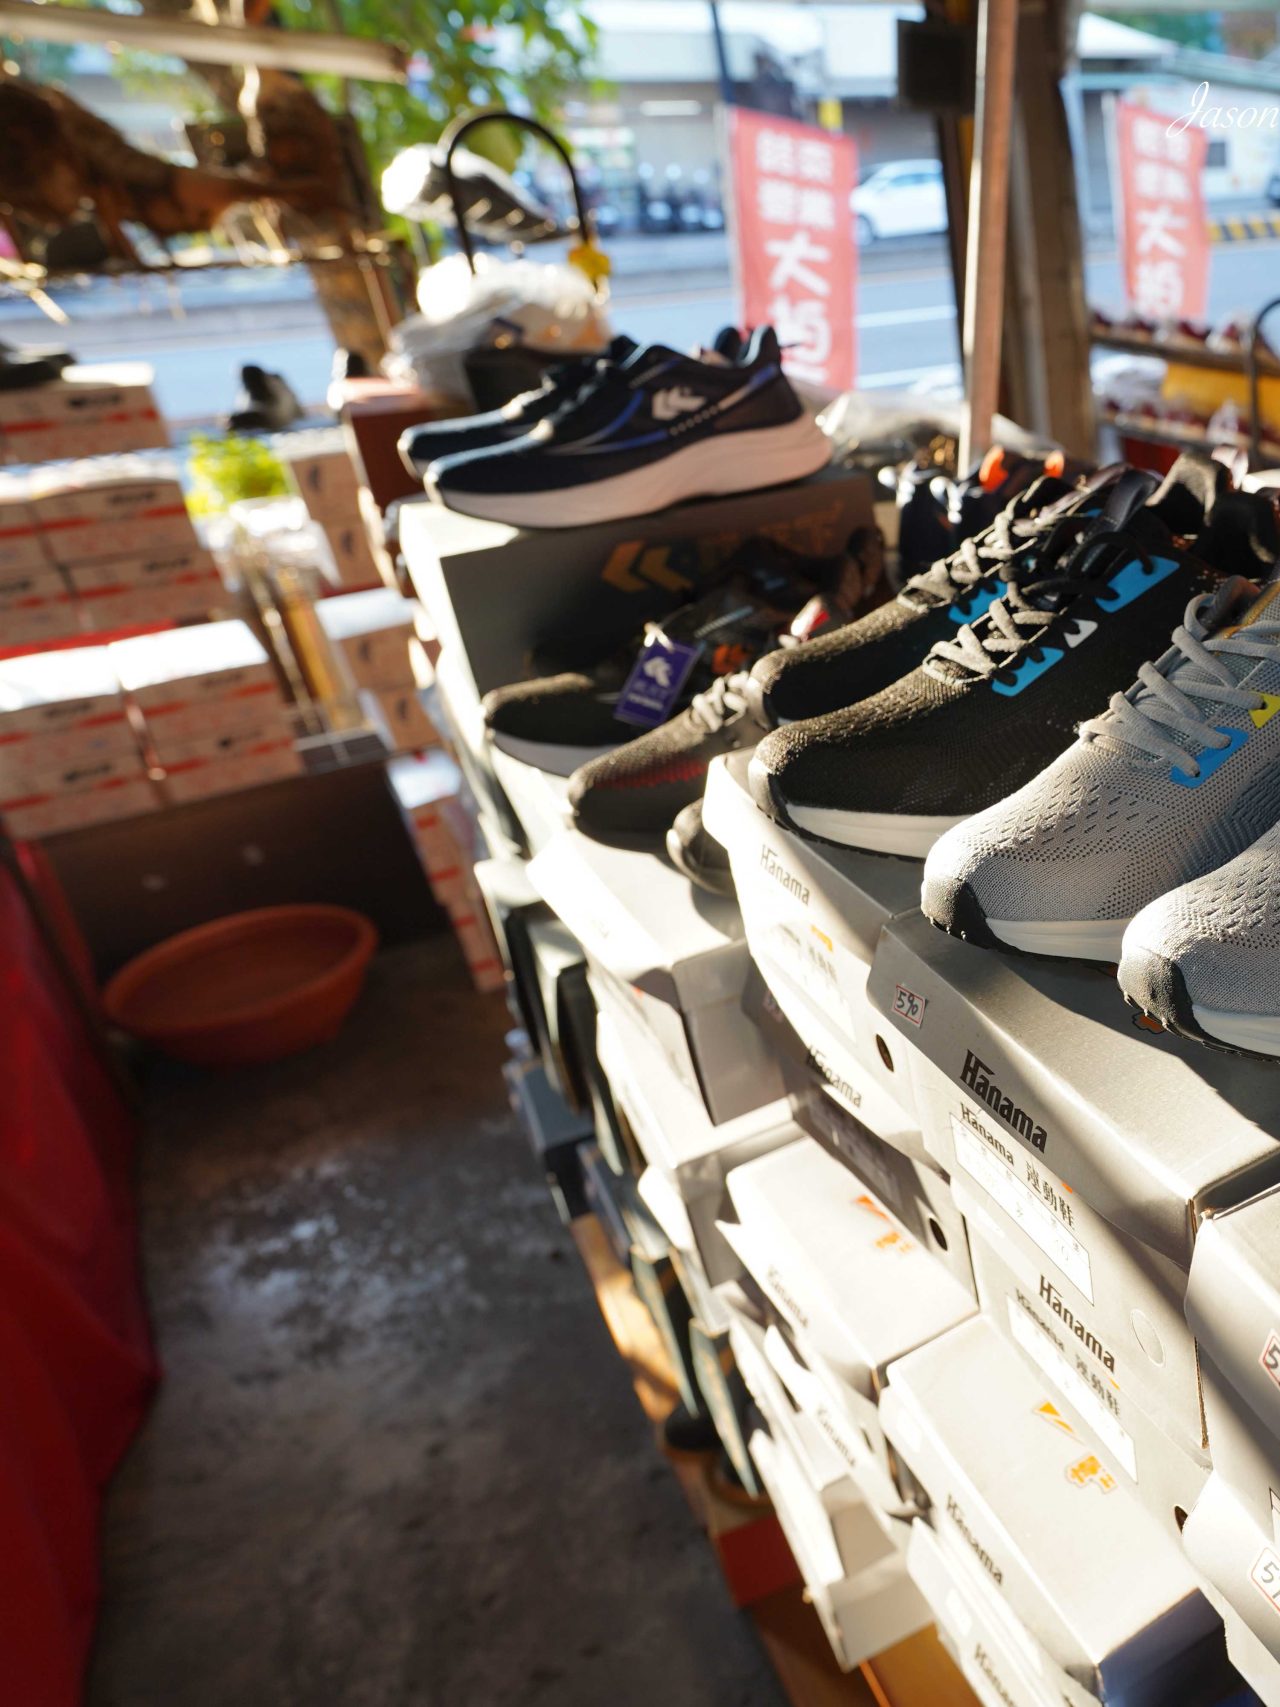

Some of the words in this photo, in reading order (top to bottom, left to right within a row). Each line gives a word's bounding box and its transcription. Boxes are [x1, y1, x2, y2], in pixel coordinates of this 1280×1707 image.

[760, 844, 811, 906] Hanama
[960, 1049, 1048, 1154] Hanama
[960, 1102, 1015, 1166] Hanama
[1025, 1160, 1076, 1230] 運動鞋
[1039, 1274, 1116, 1374] Hanama
[946, 1494, 1004, 1586] Hanama
